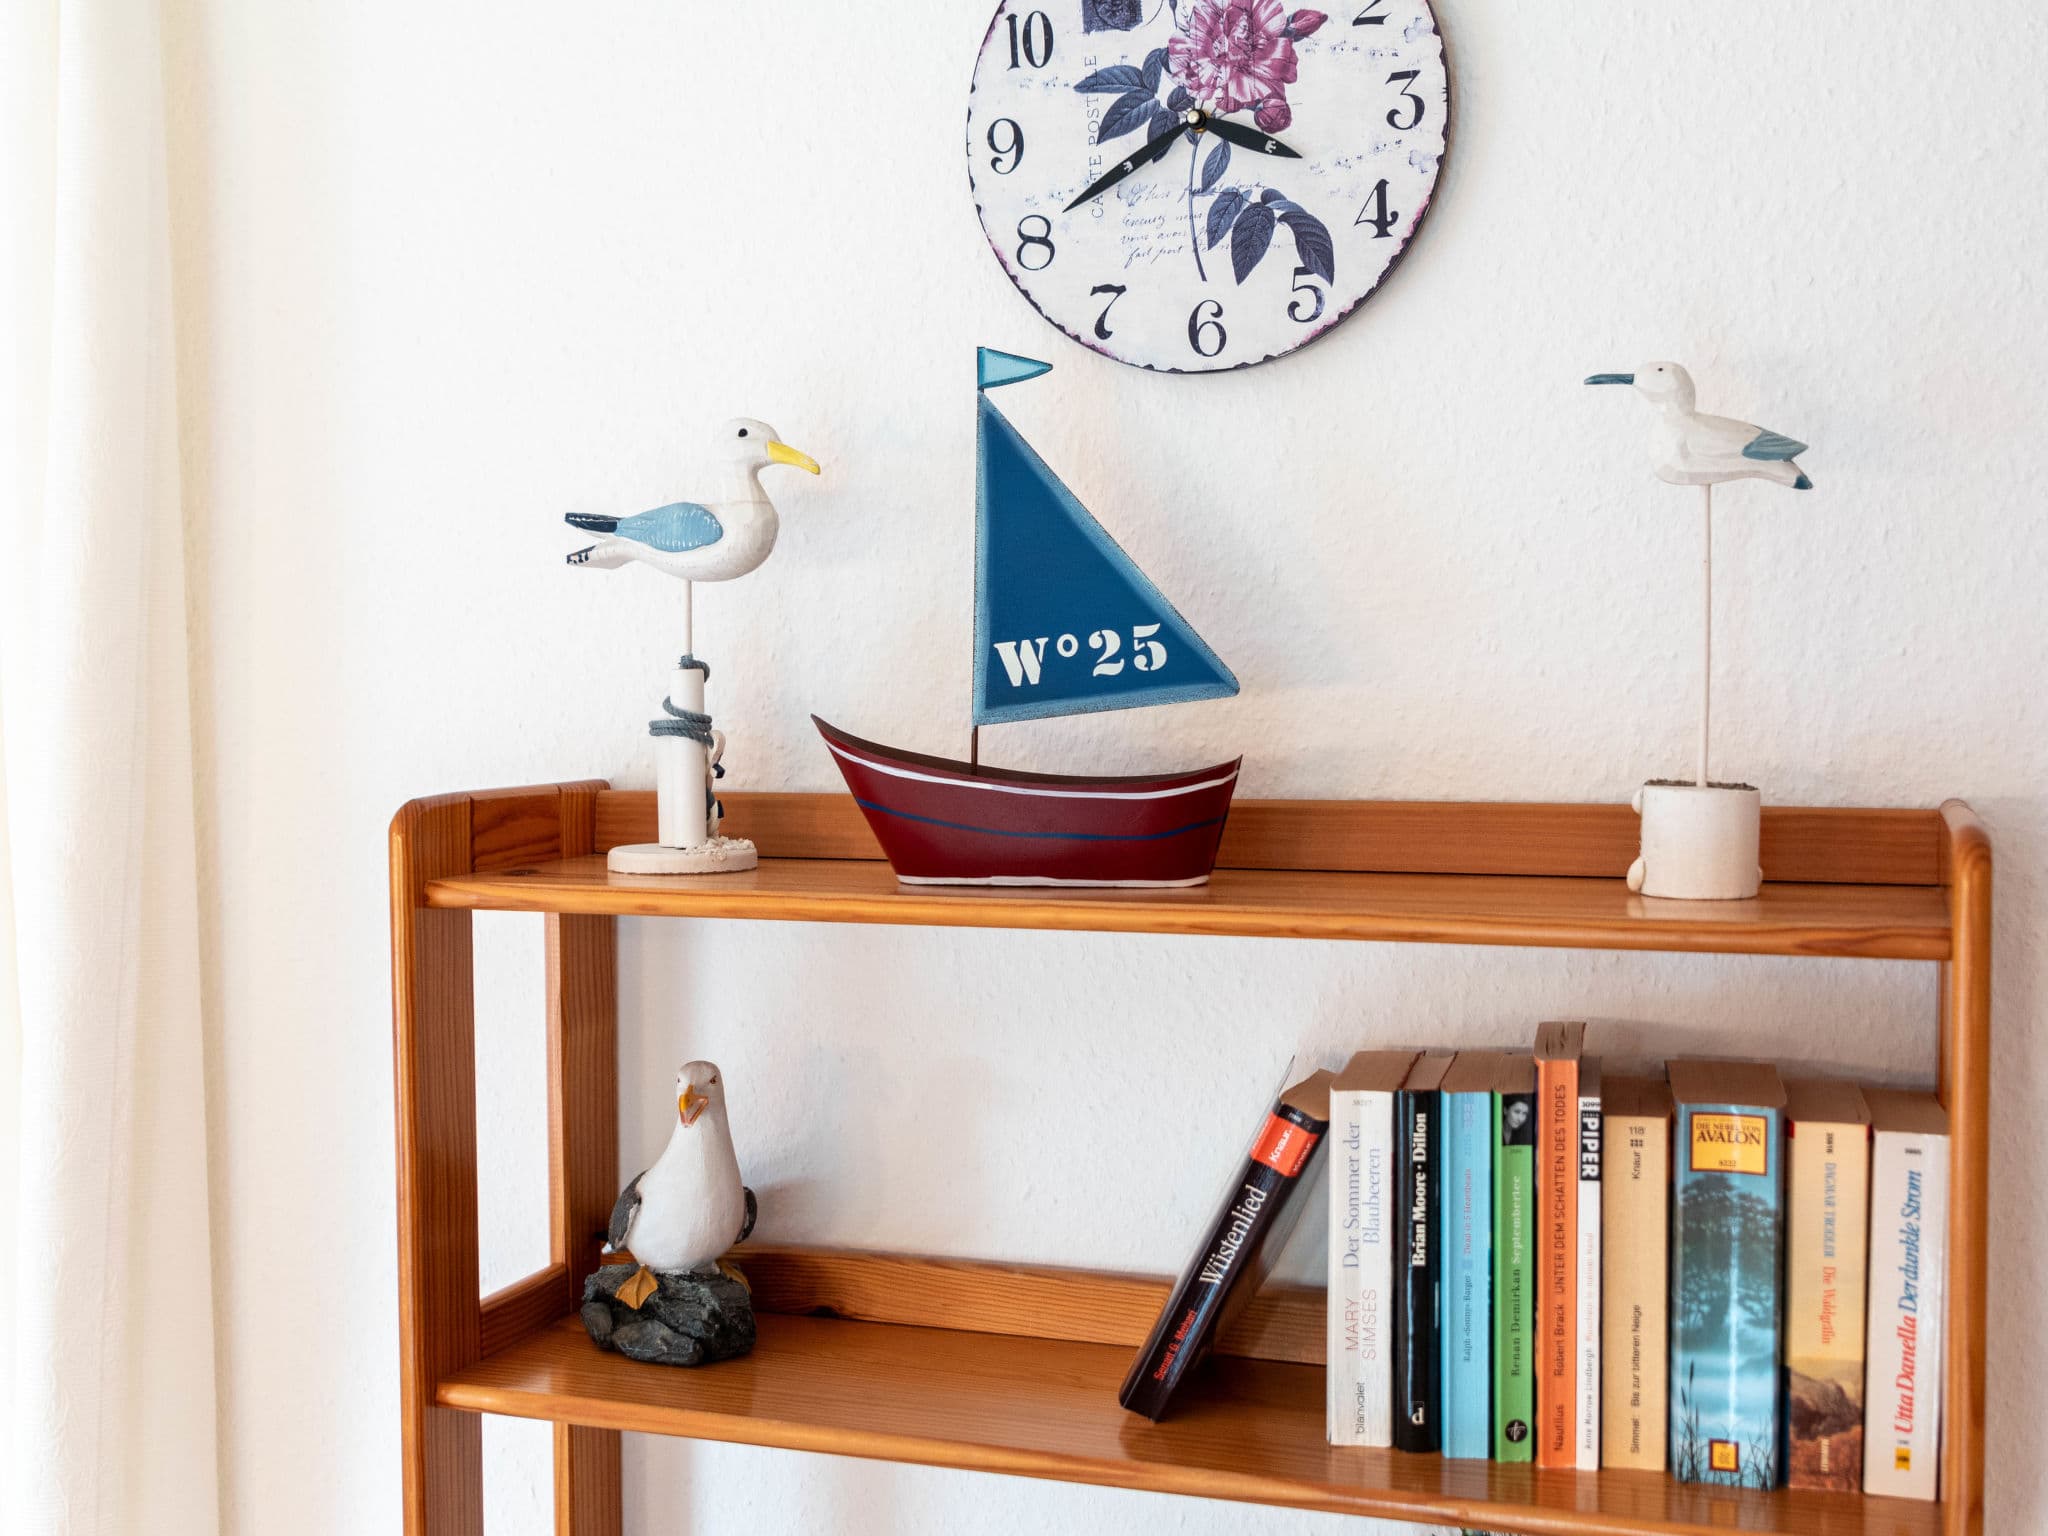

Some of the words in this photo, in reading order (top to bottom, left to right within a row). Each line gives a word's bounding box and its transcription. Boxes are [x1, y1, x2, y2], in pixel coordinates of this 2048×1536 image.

[1005, 10, 1054, 72] 10
[1084, 55, 1100, 146] POSTLE
[1386, 70, 1425, 130] 3
[986, 118, 1025, 174] 9
[1088, 154, 1104, 219] CATE
[1354, 179, 1402, 239] 4
[1016, 214, 1055, 271] 8
[1090, 284, 1127, 340] 7
[1287, 266, 1326, 323] 5
[1188, 299, 1227, 357] 6
[1554, 1084, 1566, 1124] TODES
[1345, 1122, 1360, 1150] der
[1412, 1113, 1427, 1162] Dillon
[1554, 1127, 1566, 1151] DES
[1581, 1117, 1600, 1178] PIPER
[1696, 1130, 1761, 1146] AVALON
[1343, 1155, 1360, 1230] Sommer
[1554, 1154, 1566, 1219] SCHATTEN
[1631, 1151, 1641, 1180] Knaur
[1362, 1147, 1381, 1245] Blaubeeren
[1412, 1172, 1427, 1222] Moore
[1512, 1175, 1522, 1264] Septembertee
[1905, 1170, 1922, 1222] Strom
[1199, 1184, 1268, 1286] Wüstenlied
[1343, 1236, 1360, 1269] Der
[1412, 1224, 1427, 1266] Brian
[1554, 1222, 1566, 1249] DEM
[1902, 1223, 1920, 1281] dunkle
[1463, 1274, 1474, 1302] Barger
[1511, 1268, 1521, 1332] Demirkan
[1554, 1252, 1566, 1294] UNTER
[1822, 1265, 1836, 1284] Die
[1899, 1282, 1918, 1314] Der
[1345, 1297, 1361, 1352] MARY
[1362, 1288, 1377, 1361] SIMSES
[1554, 1303, 1566, 1336] Brack
[1462, 1339, 1473, 1363] Ralph
[1511, 1338, 1521, 1377] Renan
[1554, 1339, 1566, 1377] Robert
[1896, 1315, 1917, 1393] Danella
[1354, 1381, 1366, 1435] blanvalet
[1554, 1403, 1566, 1453] Nautilus
[1894, 1395, 1914, 1434] Utta
